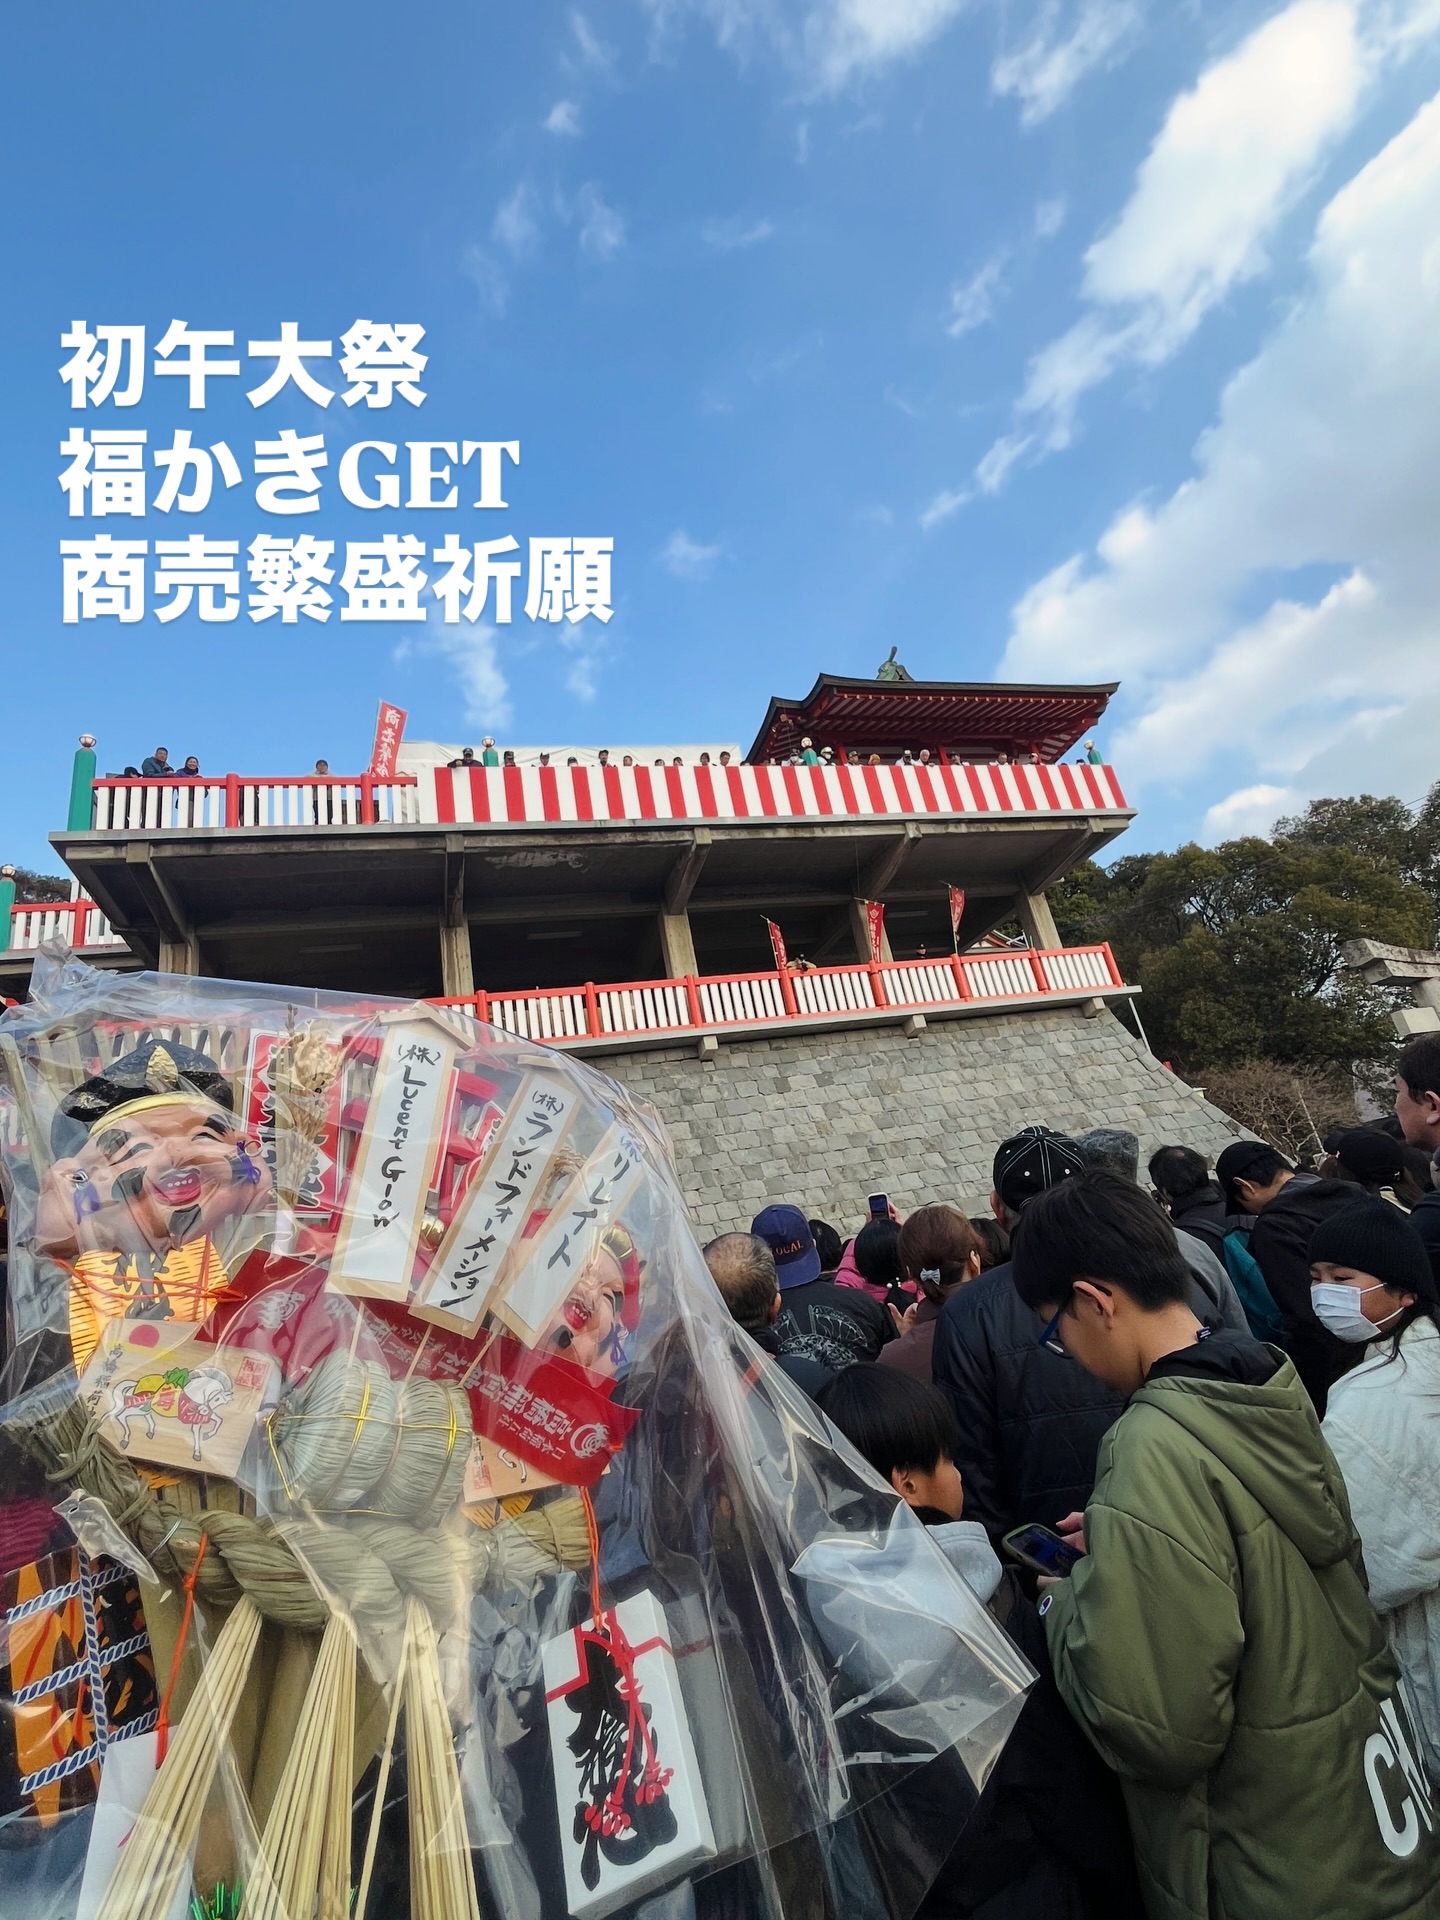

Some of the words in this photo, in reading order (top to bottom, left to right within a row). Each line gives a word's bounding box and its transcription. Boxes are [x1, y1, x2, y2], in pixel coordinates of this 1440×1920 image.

[372, 1156, 407, 1228] Glow
[547, 1135, 642, 1270] (株リレイト
[775, 1240, 804, 1255] OCAL
